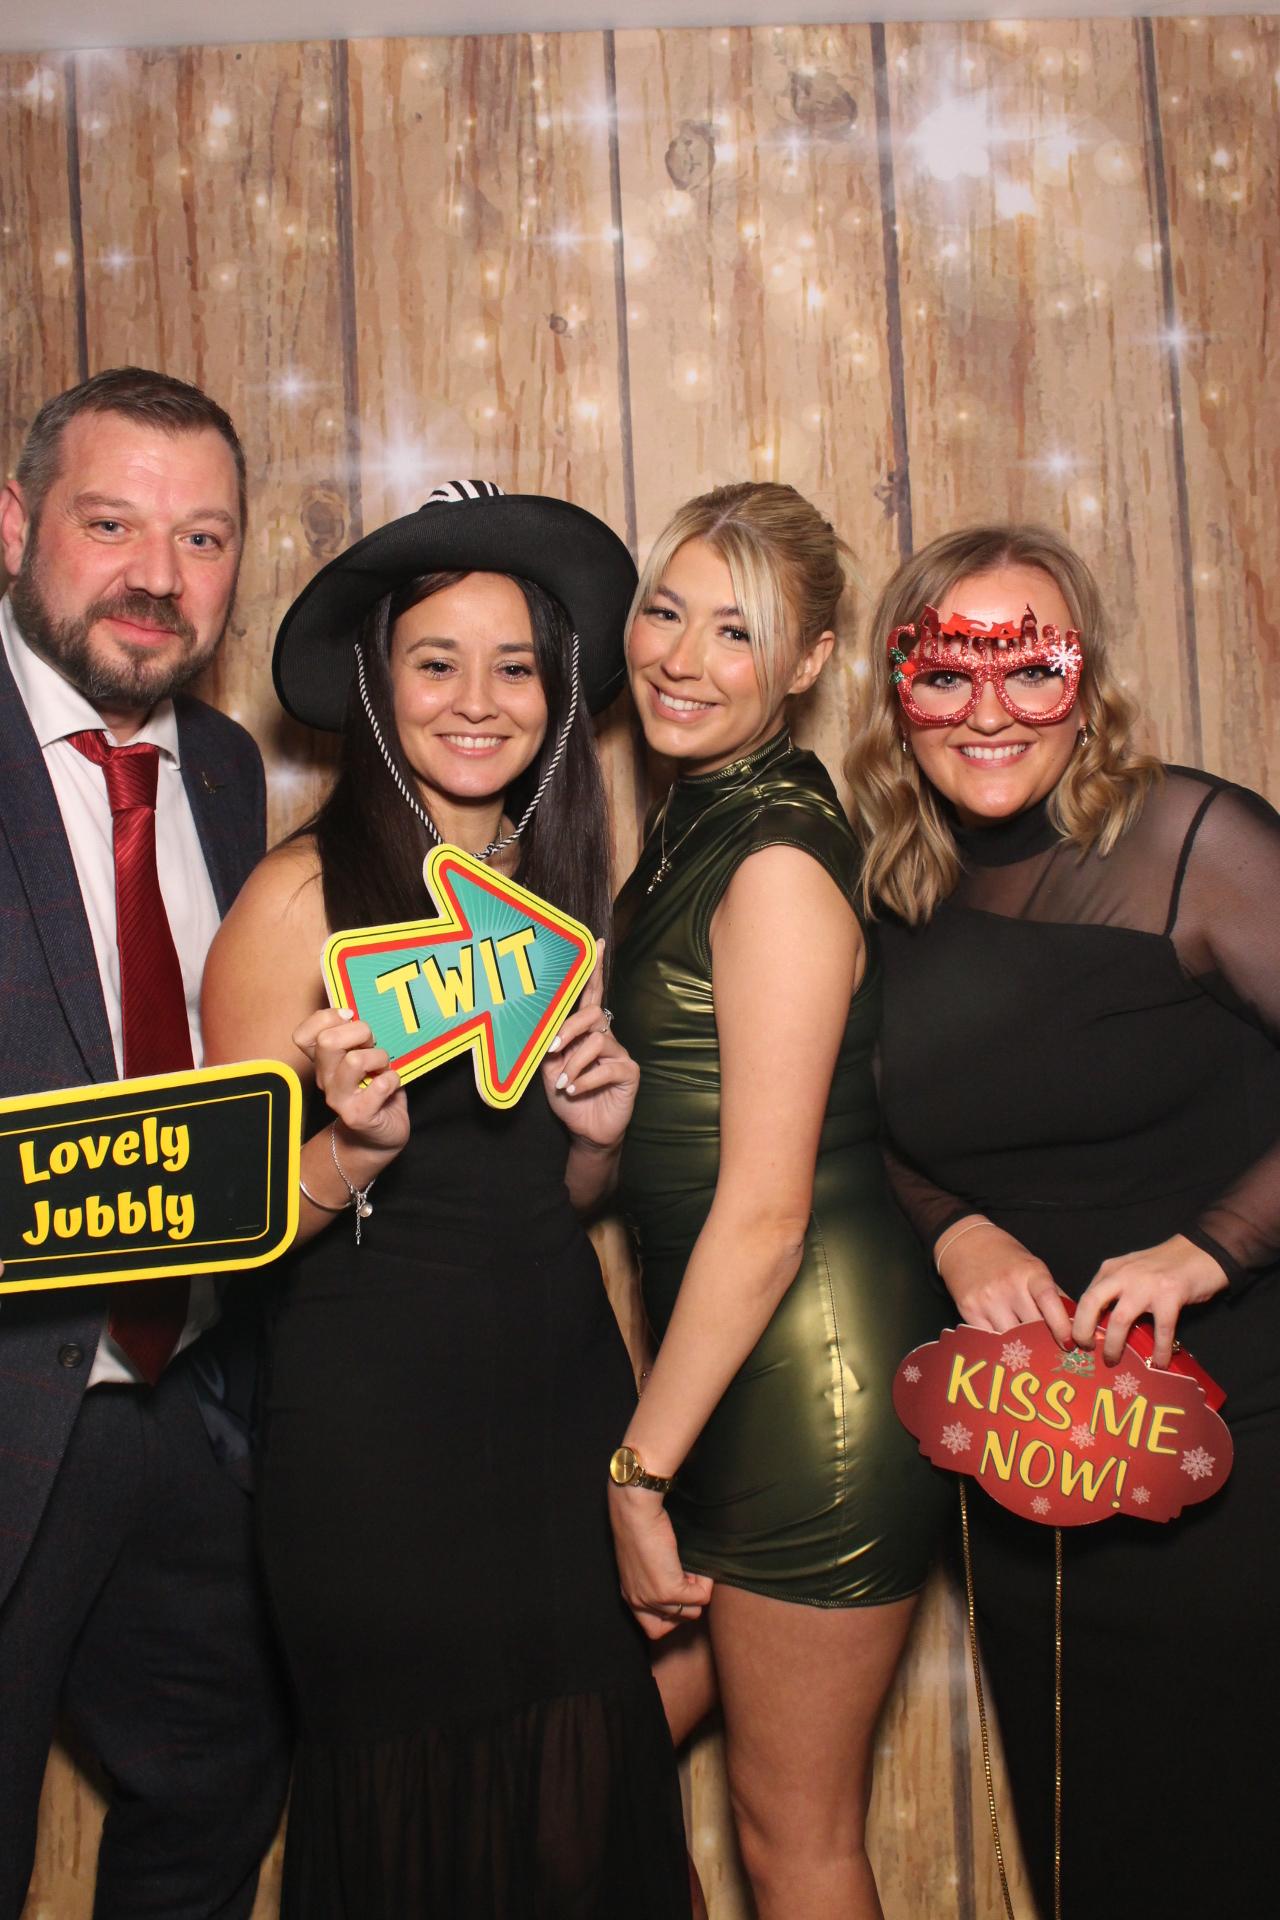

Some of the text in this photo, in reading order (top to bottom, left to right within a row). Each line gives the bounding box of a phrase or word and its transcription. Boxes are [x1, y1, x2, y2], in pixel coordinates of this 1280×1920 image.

[375, 925, 537, 1034] TWIT
[19, 1116, 190, 1185] Lovely
[22, 1184, 195, 1246] Jubbly
[947, 1354, 1186, 1455] KISS ME
[979, 1429, 1129, 1509] NOW!
